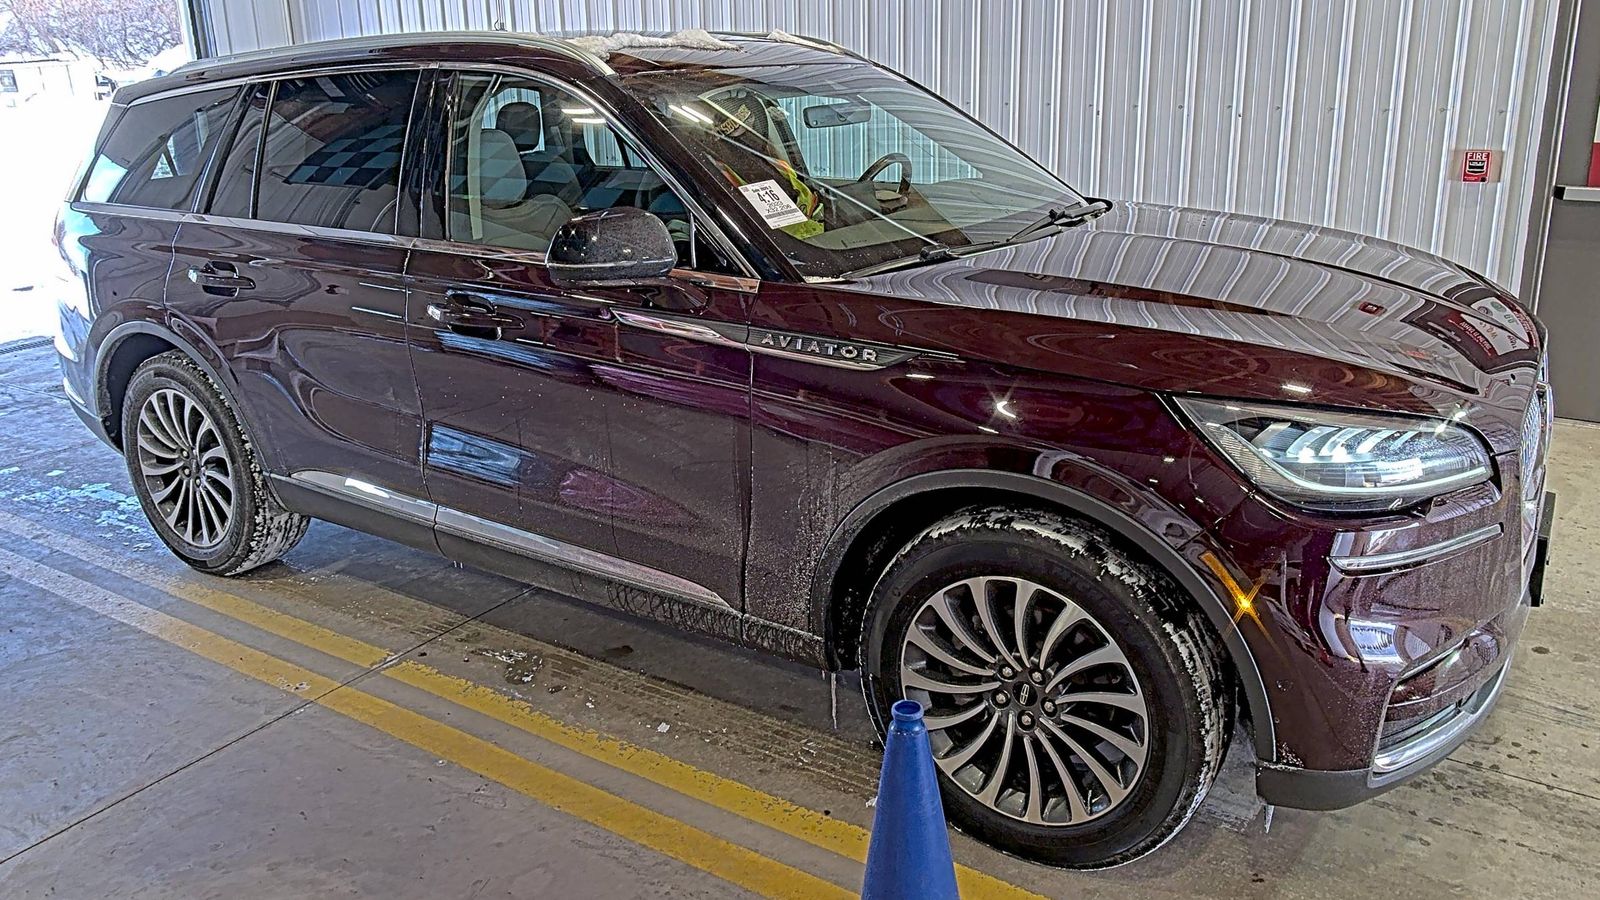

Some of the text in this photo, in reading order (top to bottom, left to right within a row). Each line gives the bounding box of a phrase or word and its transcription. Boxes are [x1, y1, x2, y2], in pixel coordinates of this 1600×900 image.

[1467, 152, 1488, 160] FIRE
[757, 189, 780, 204] 4:16
[761, 333, 878, 362] AVIATOR
